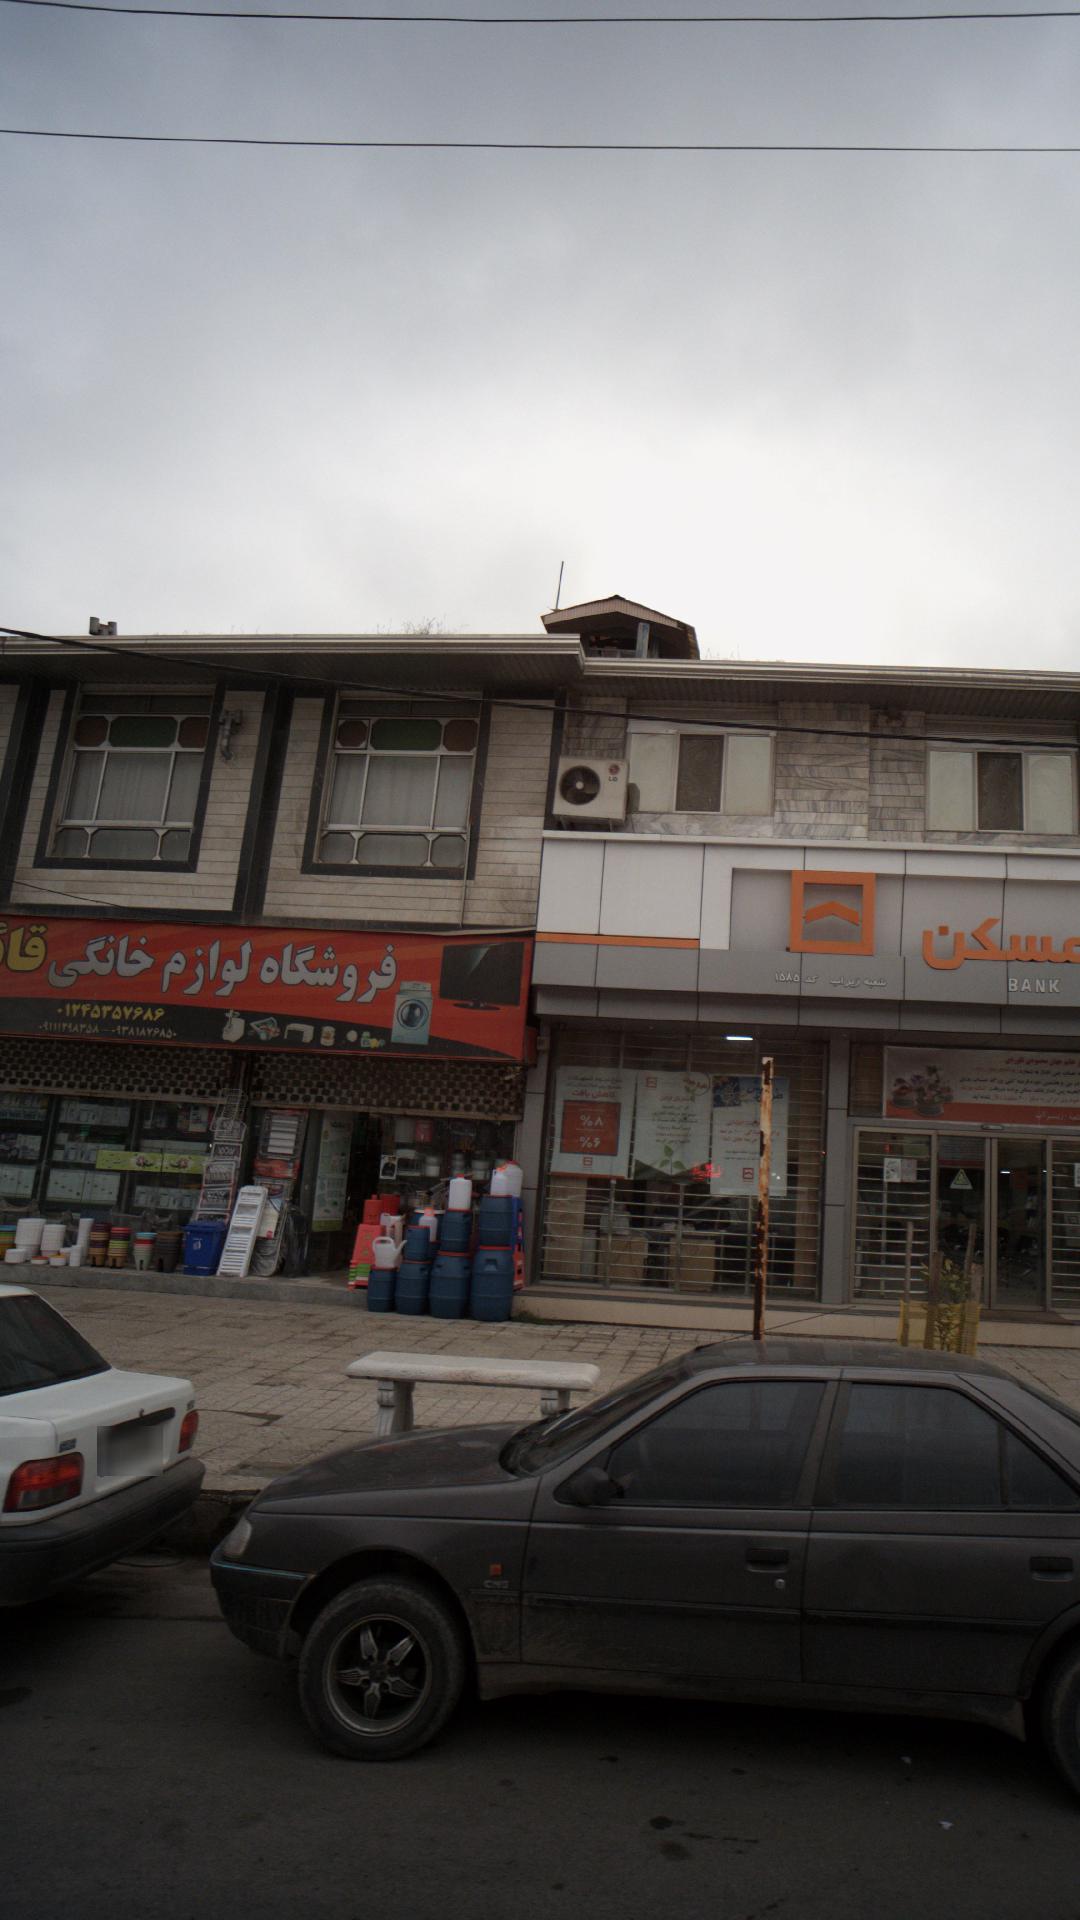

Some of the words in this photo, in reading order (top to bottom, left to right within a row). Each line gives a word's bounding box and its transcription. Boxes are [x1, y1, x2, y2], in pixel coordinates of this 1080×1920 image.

[47, 935, 156, 988] خانگی
[160, 938, 252, 996] لوازم
[260, 942, 397, 1003] فروشگاه
[774, 971, 801, 984] ۱۵۸۵
[804, 974, 820, 985] کد
[863, 975, 888, 989] شعبه
[1008, 978, 1060, 993] BANK
